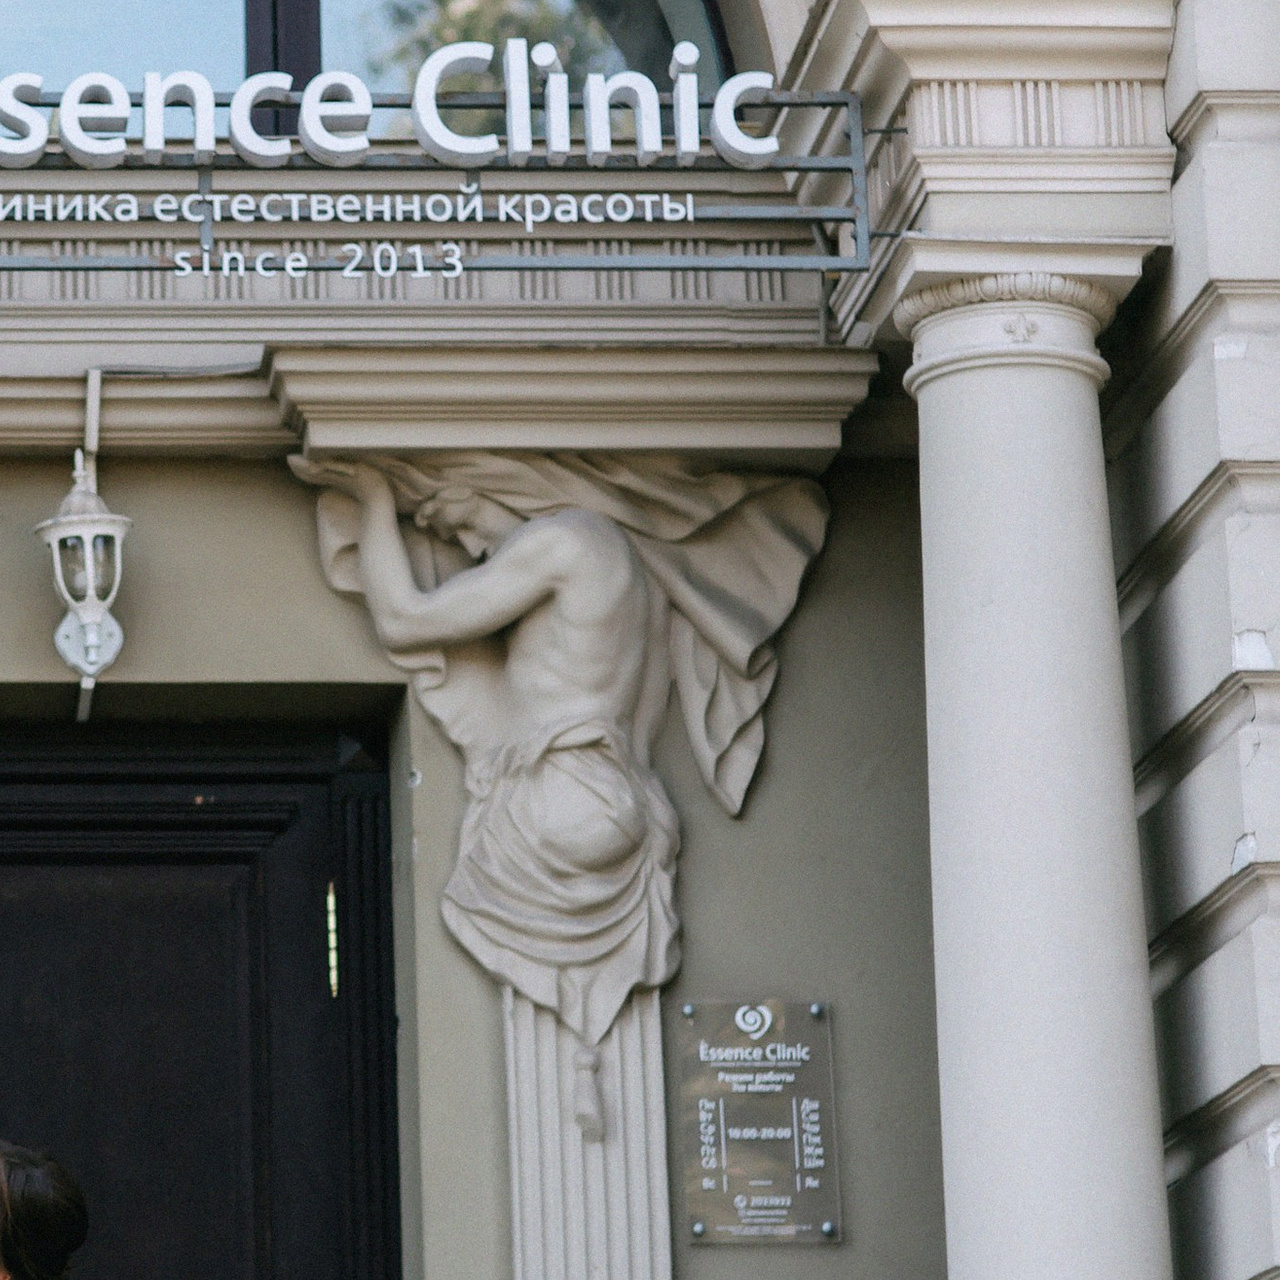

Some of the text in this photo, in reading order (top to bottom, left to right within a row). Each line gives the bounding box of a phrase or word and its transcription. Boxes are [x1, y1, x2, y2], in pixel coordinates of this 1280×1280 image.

[412, 38, 780, 169] Clinic
[153, 184, 483, 222] естественной
[498, 192, 695, 233] красоты
[174, 243, 465, 277] since 2013
[765, 1042, 810, 1061] Clinic
